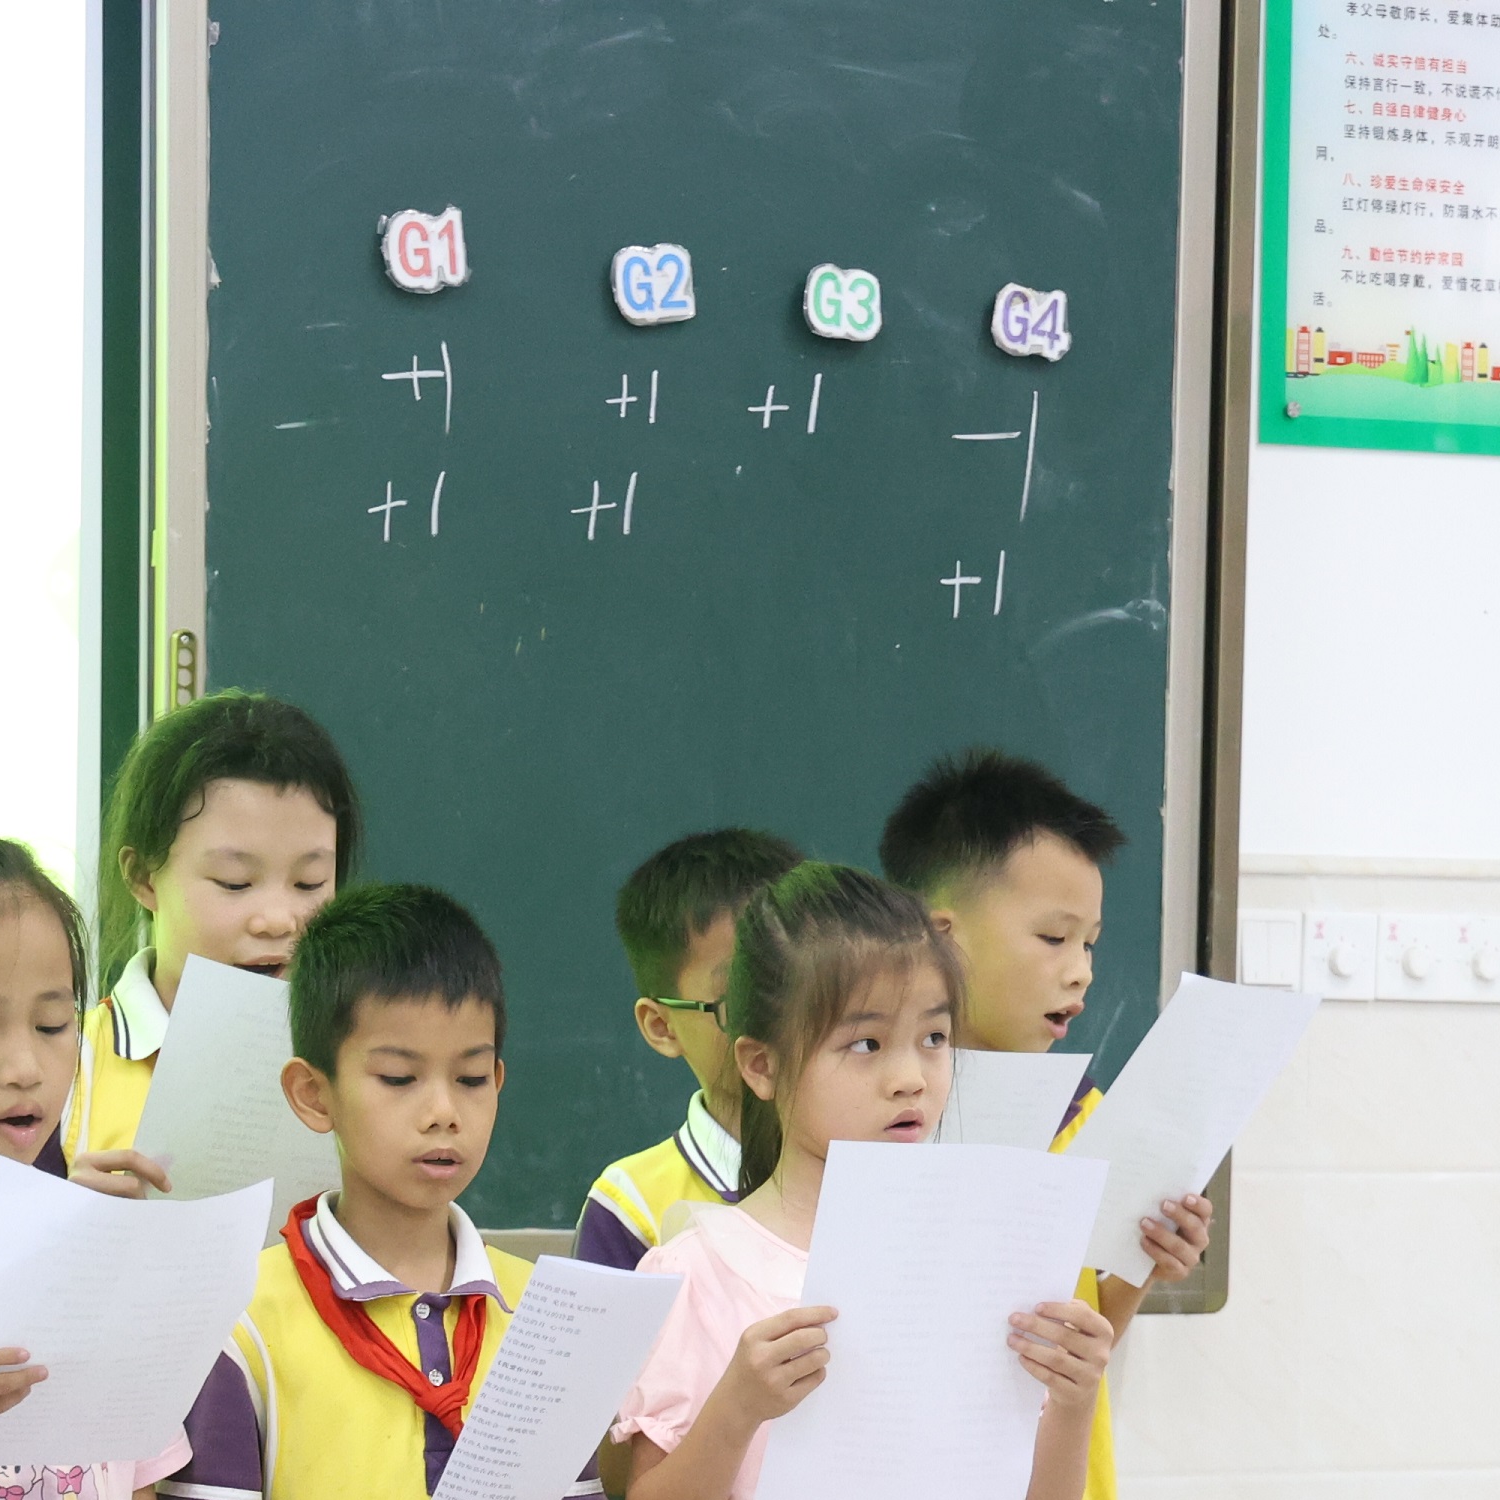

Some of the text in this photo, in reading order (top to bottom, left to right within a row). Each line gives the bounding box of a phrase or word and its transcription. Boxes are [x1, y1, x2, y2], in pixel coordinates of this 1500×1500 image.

[1344, 52, 1468, 75] 六、诚实守信有担当
[1342, 173, 1466, 195] 八、珍爱生命保安全
[397, 221, 459, 279] G1
[621, 254, 692, 313] G2
[811, 275, 877, 333] G3
[1001, 289, 1063, 347] G4
